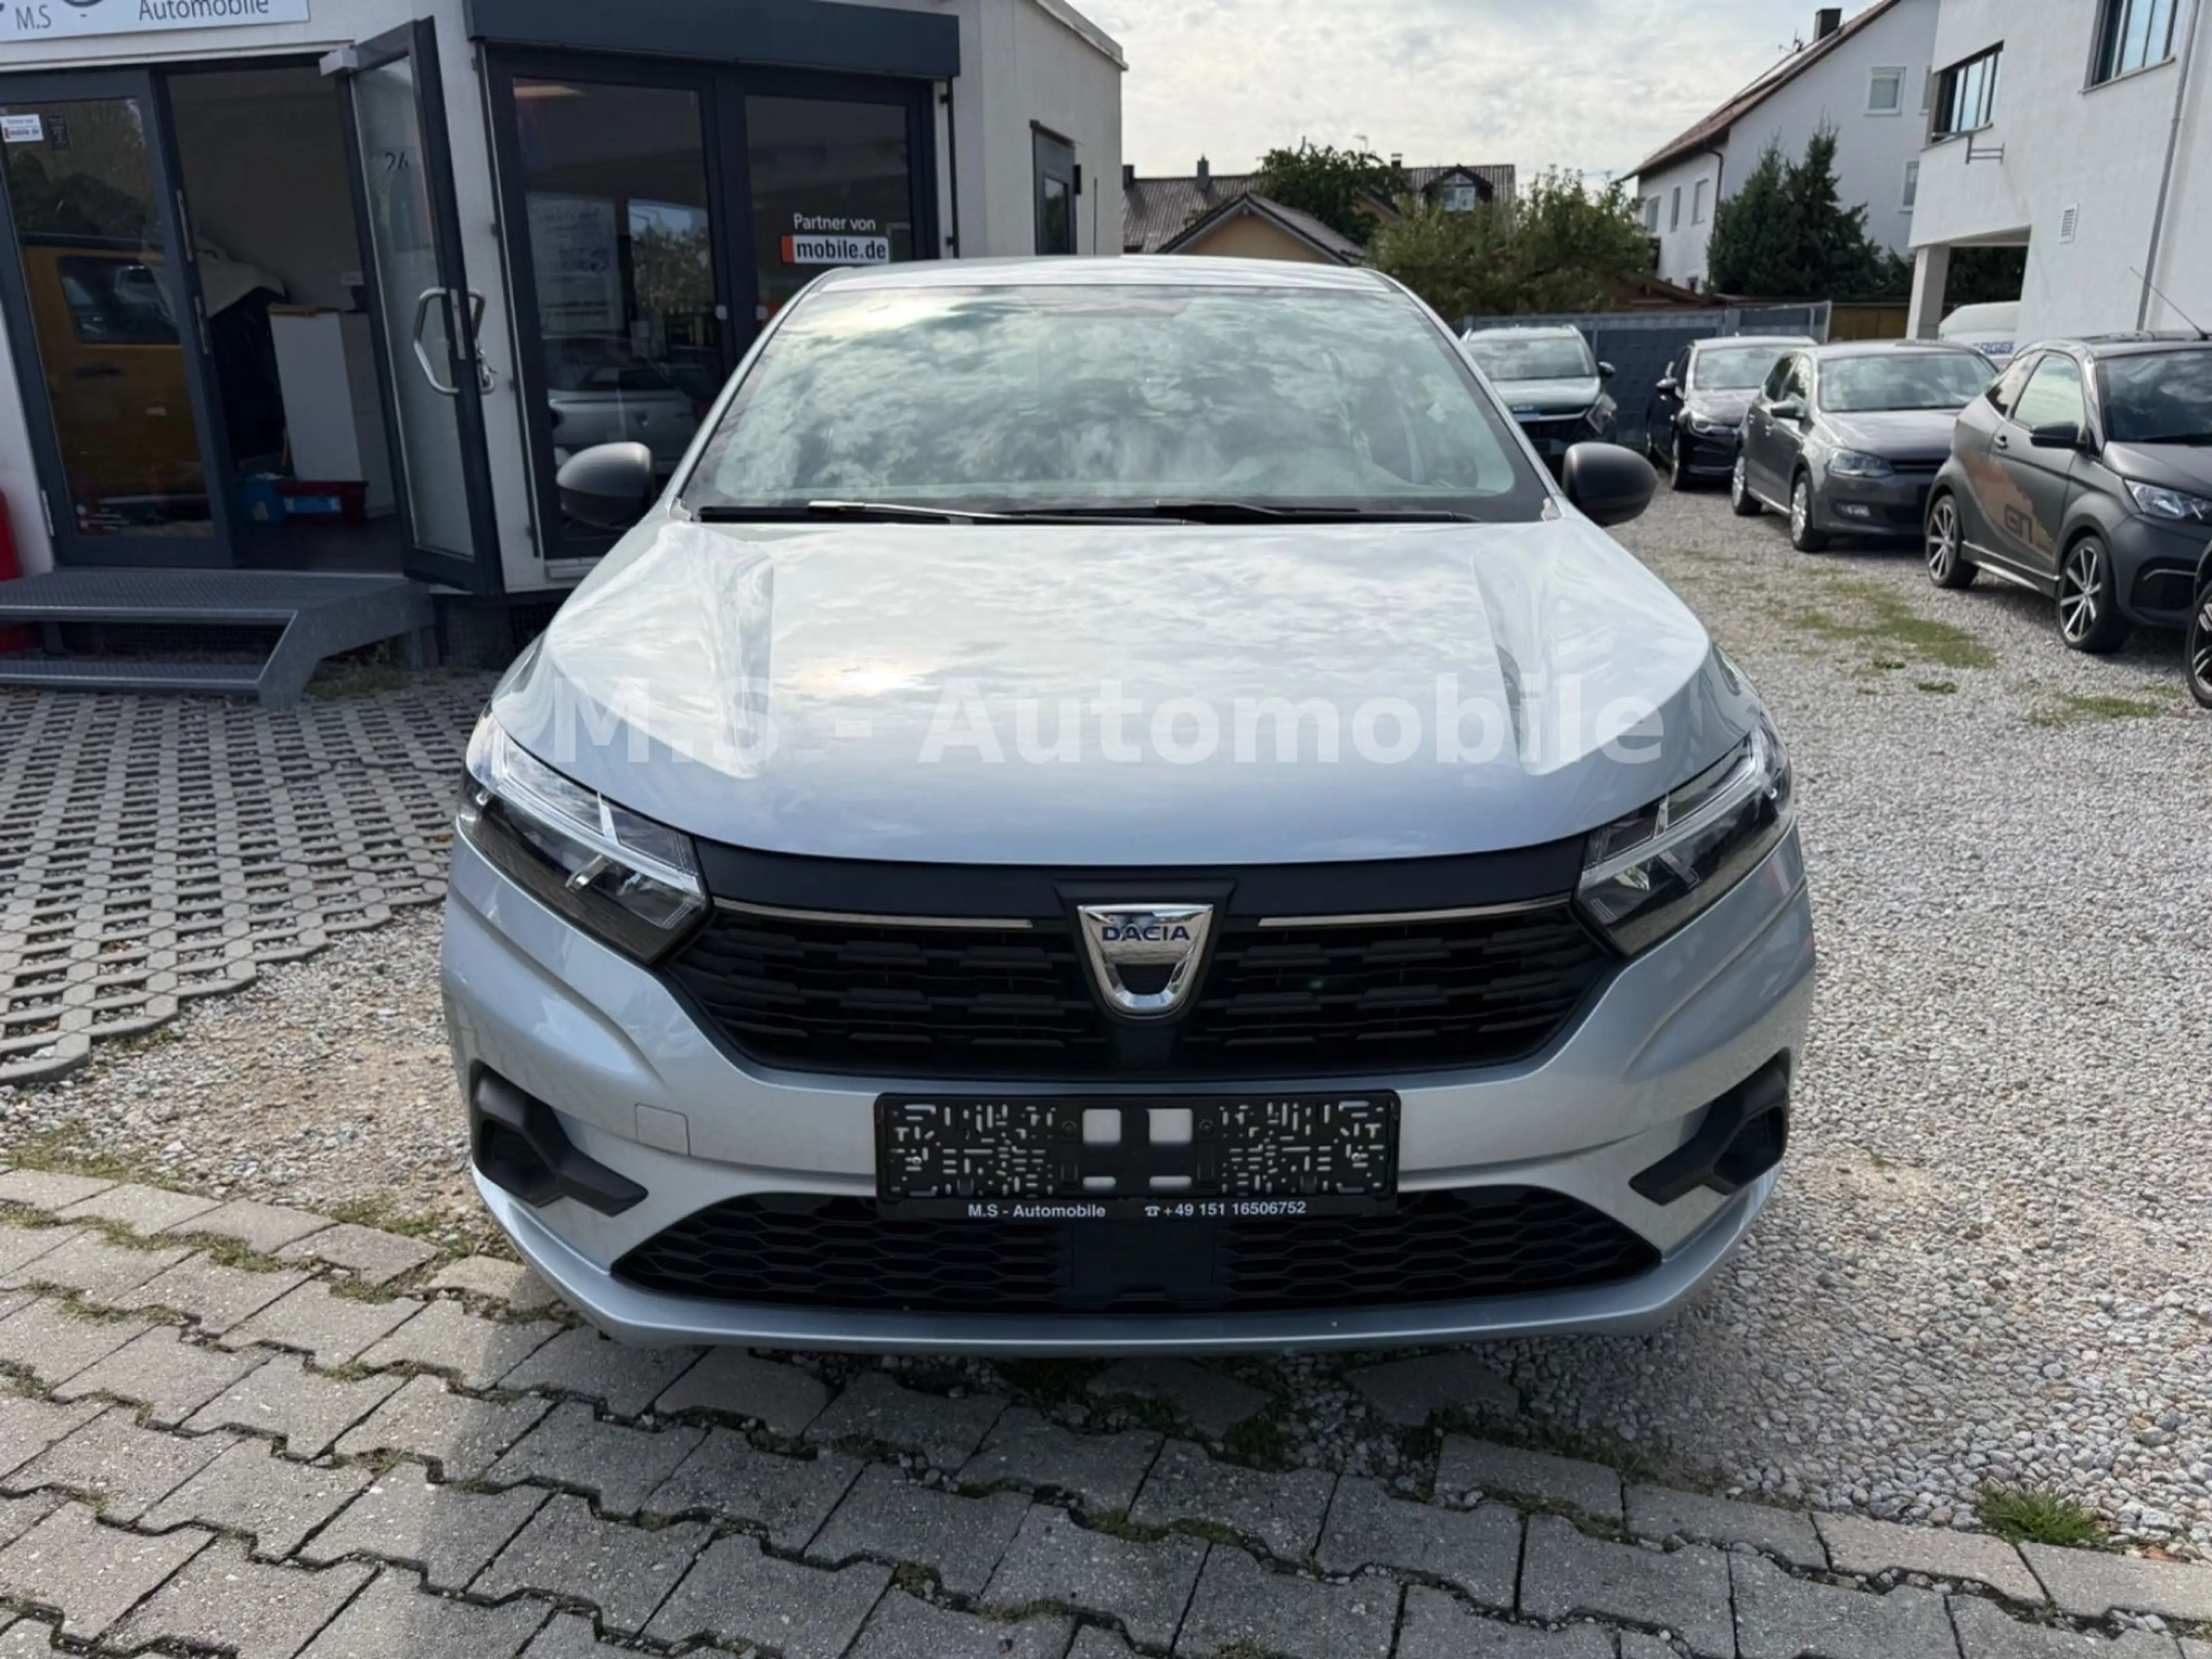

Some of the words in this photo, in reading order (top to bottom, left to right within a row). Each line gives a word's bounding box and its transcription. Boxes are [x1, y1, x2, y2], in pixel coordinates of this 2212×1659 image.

[15, 4, 52, 30] M.S
[139, 0, 270, 21] Automobile
[793, 213, 847, 230] Partner
[849, 218, 877, 232] von
[796, 238, 886, 259] mobile.de
[1101, 925, 1191, 941] DACIA
[968, 1204, 998, 1217] M.S
[1013, 1203, 1106, 1218] Automobile
[1164, 1203, 1194, 1216] +49
[1199, 1203, 1225, 1216] 151
[1232, 1201, 1306, 1215] 16506752
